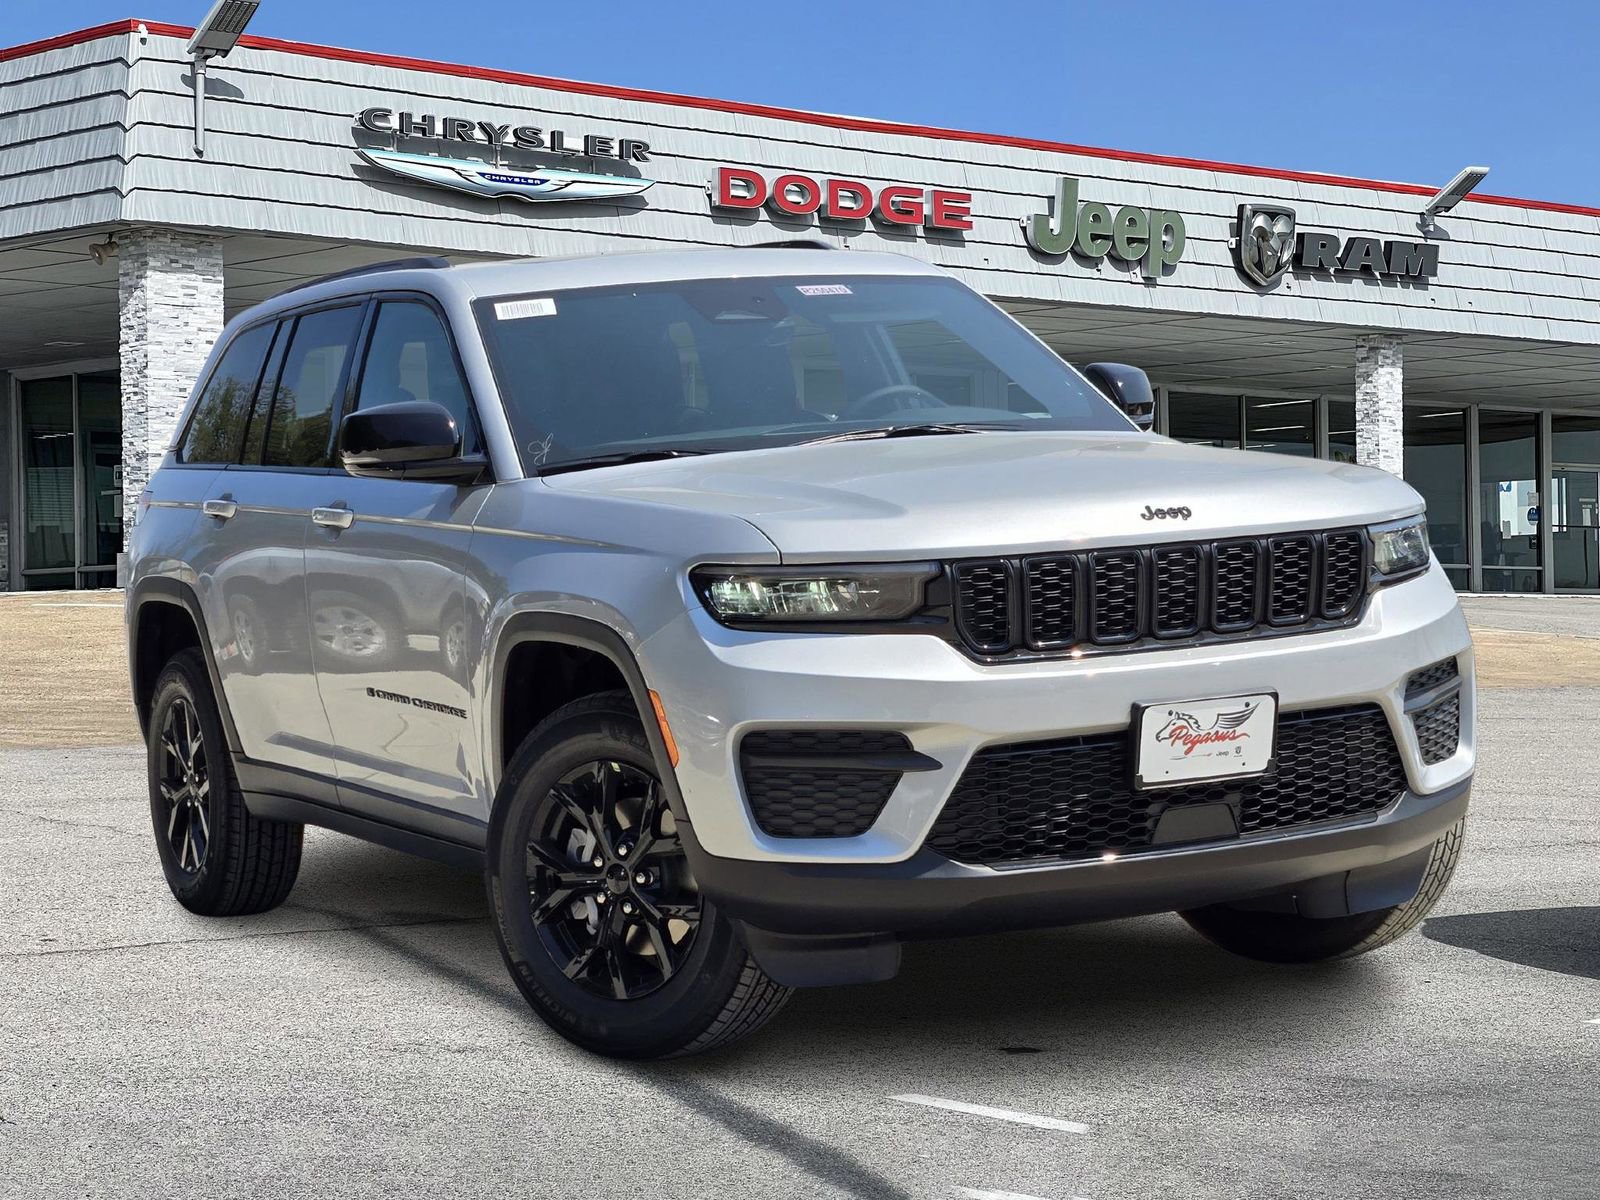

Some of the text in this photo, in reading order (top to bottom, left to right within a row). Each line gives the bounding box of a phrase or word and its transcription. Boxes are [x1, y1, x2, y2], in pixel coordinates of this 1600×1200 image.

[358, 107, 651, 162] CHRYSLER
[484, 174, 541, 185] CHRYSLER
[712, 167, 973, 230] DODGE
[1028, 177, 1186, 278] Jeep
[1300, 232, 1440, 277] RAM
[1140, 505, 1192, 521] Jeep
[411, 698, 467, 719] CHEROKEE
[1169, 725, 1250, 756] Pegasus
